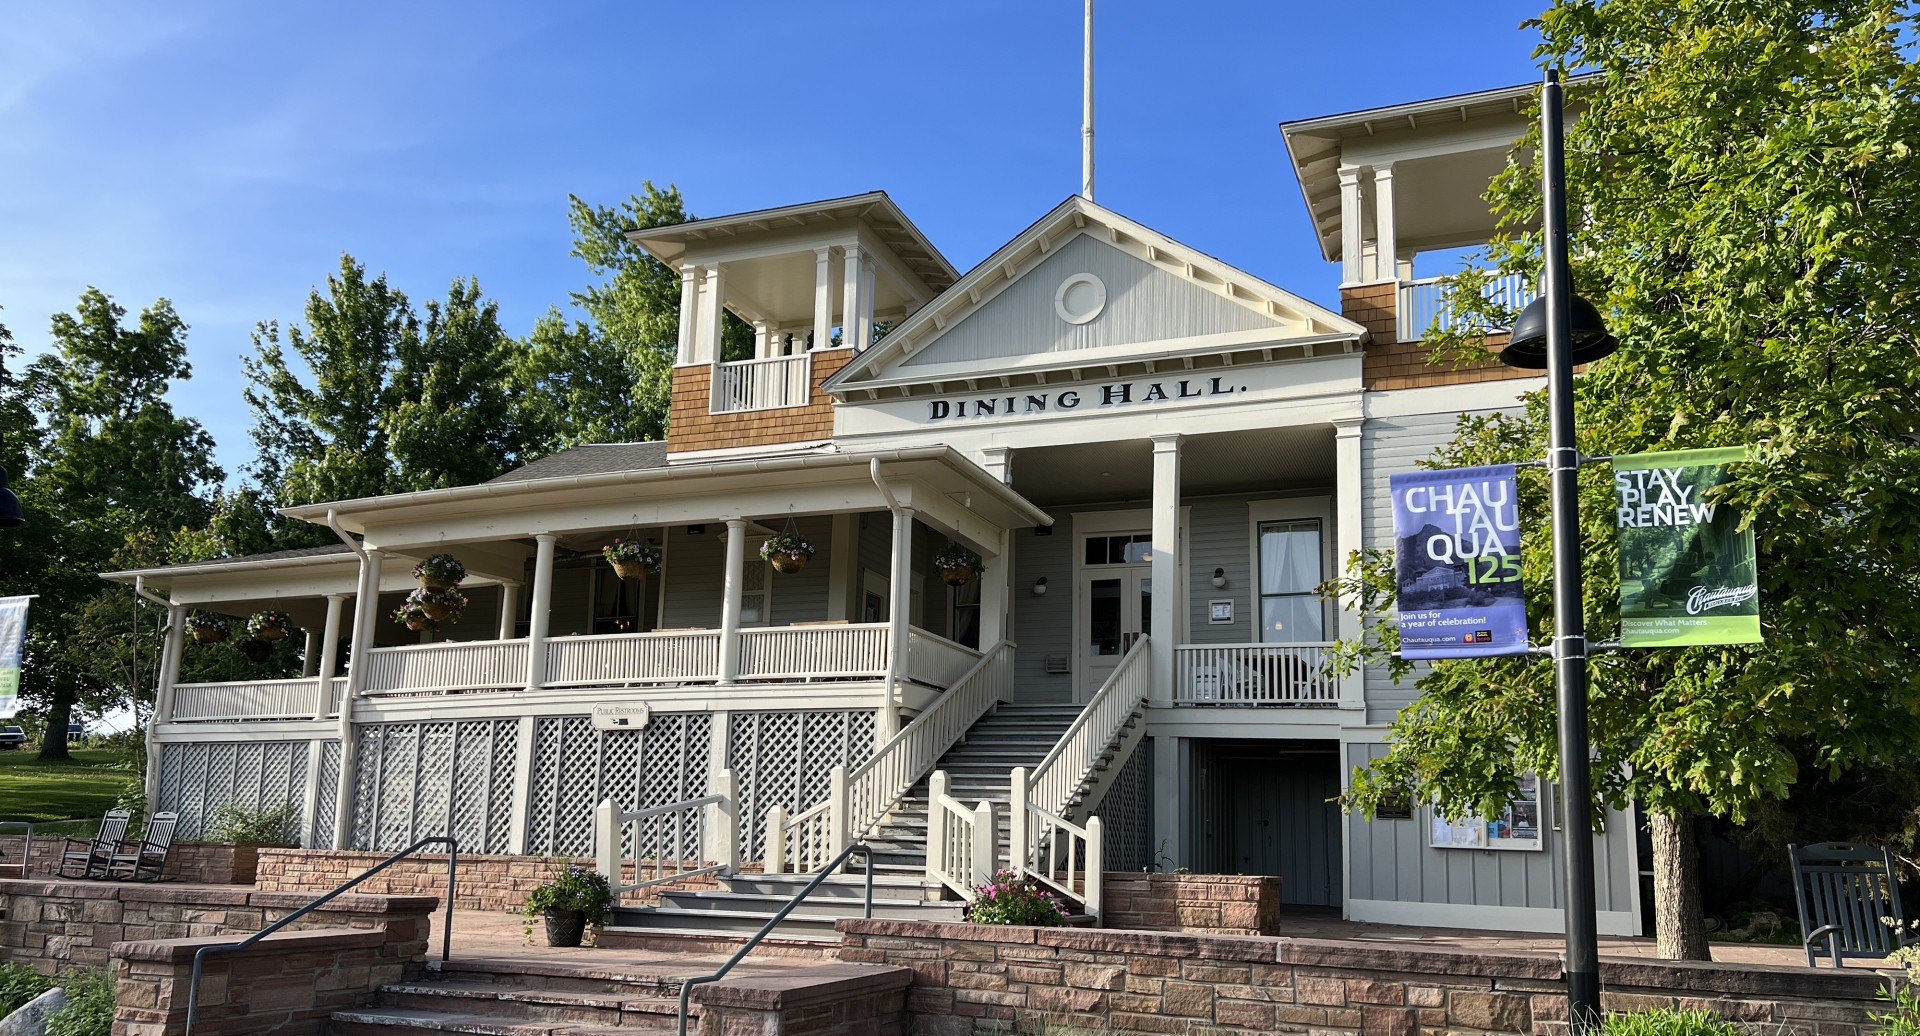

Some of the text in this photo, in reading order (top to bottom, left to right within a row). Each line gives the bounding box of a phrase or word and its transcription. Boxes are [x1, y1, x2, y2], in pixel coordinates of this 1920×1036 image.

[929, 376, 1248, 420] DINING HALL.
[1614, 467, 1684, 490] STAY
[1405, 480, 1508, 513] CHAU
[1622, 485, 1694, 508] PLAY
[1445, 504, 1519, 534] TAU
[1617, 503, 1717, 528] RENEW
[1426, 532, 1508, 565] QUA
[1463, 554, 1523, 585] 125
[1686, 585, 1757, 615] Chautauqua
[1400, 613, 1416, 621] Join
[1428, 611, 1441, 619] for
[1407, 621, 1426, 629] year
[1427, 619, 1436, 627] of
[1437, 616, 1487, 626] celebration!
[1655, 619, 1676, 627] What
[1402, 636, 1456, 644] Chautauqua.com
